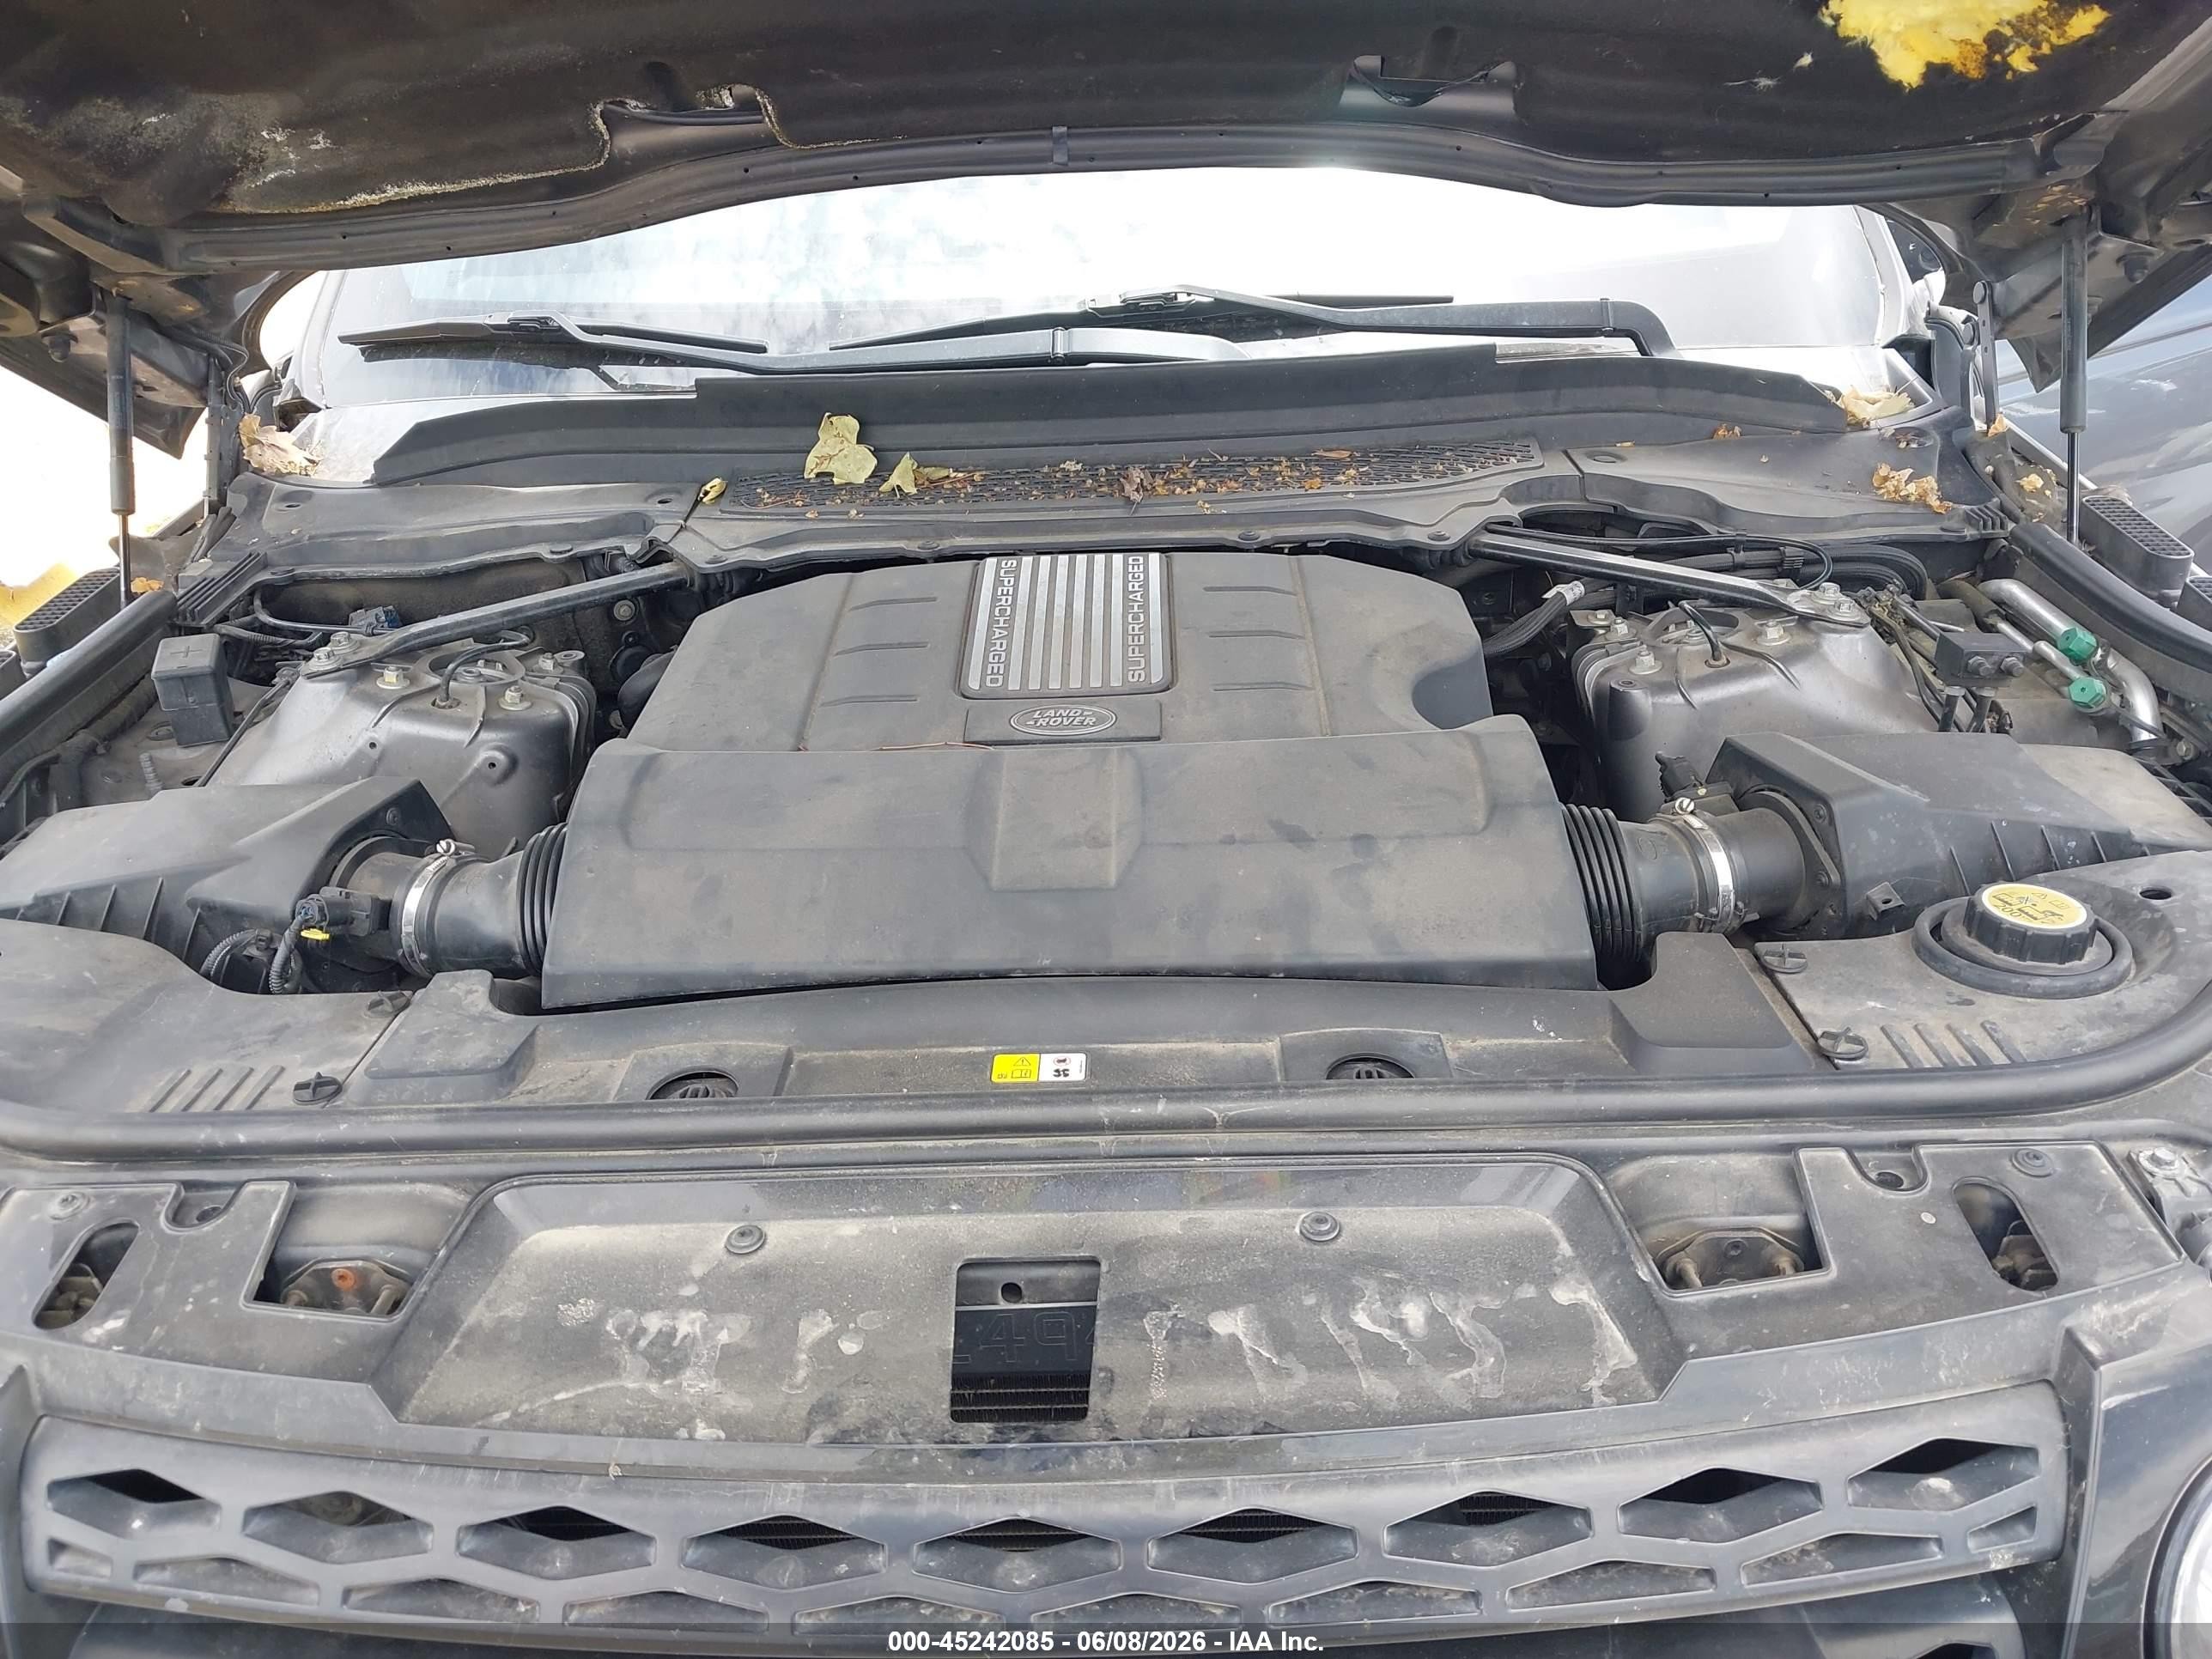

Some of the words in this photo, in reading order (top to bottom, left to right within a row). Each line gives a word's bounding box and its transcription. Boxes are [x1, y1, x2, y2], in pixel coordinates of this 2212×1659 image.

[985, 559, 1017, 687] SUPERCHARGED
[1127, 556, 1146, 683] SUPERCHARGED
[1032, 708, 1083, 719] LAND
[1036, 716, 1097, 727] ROVER
